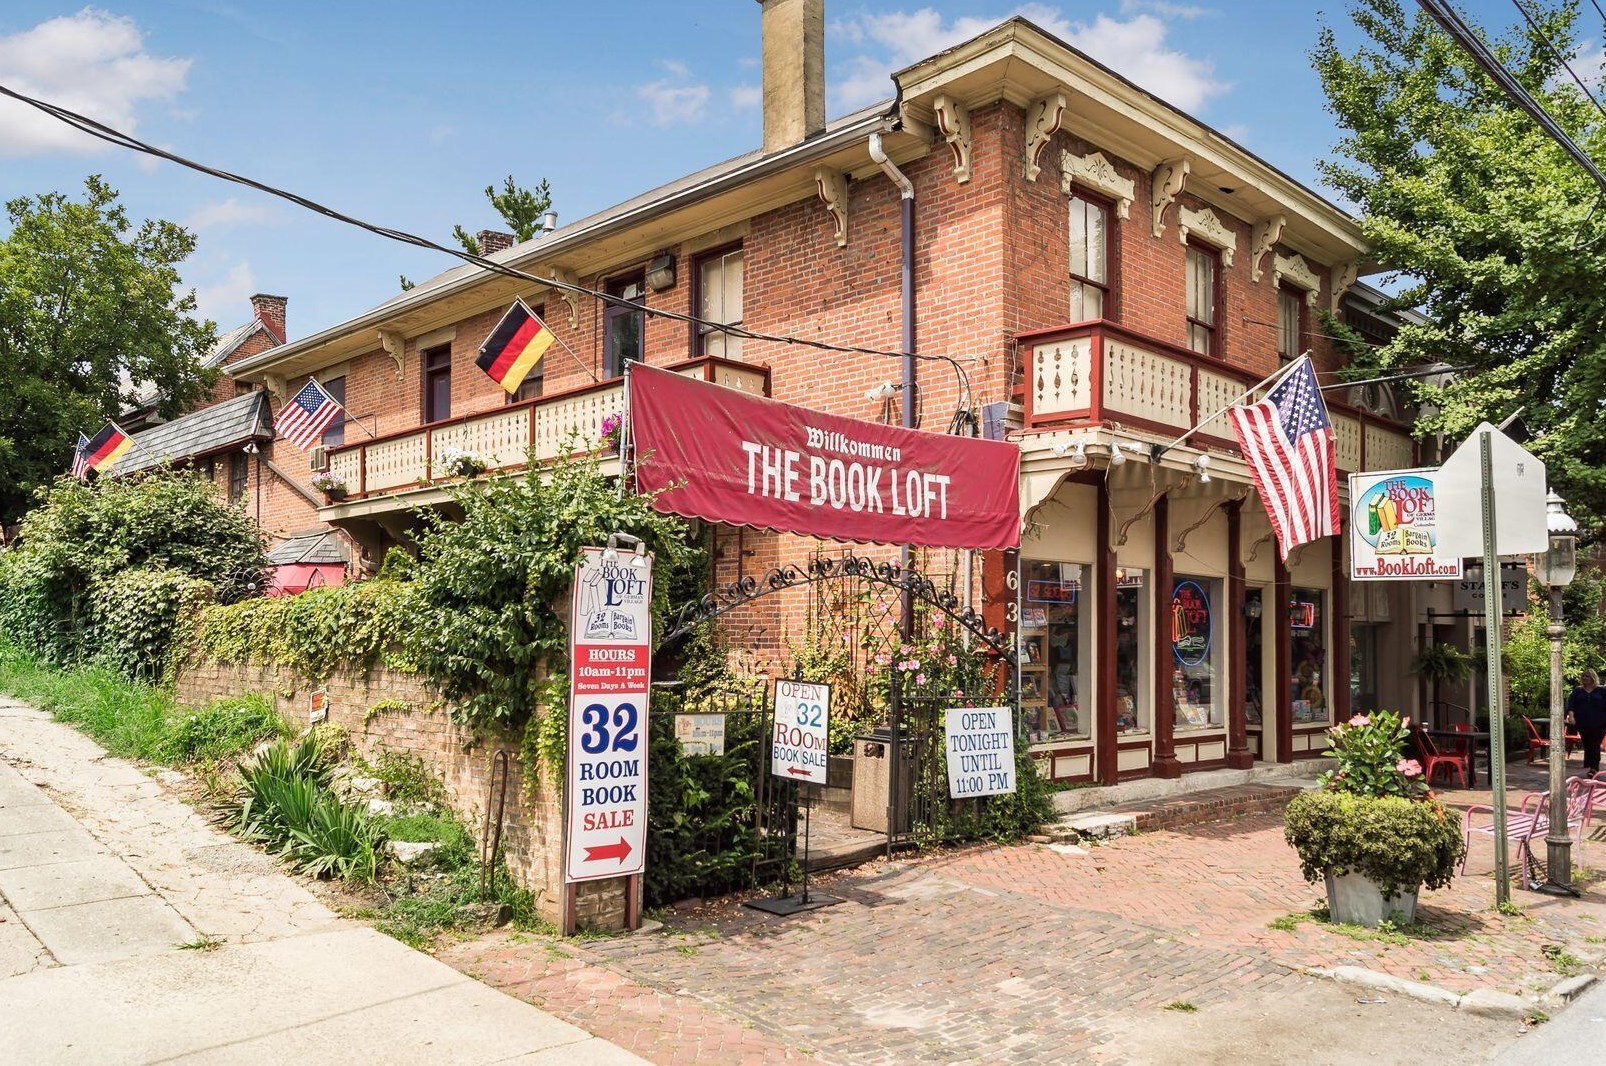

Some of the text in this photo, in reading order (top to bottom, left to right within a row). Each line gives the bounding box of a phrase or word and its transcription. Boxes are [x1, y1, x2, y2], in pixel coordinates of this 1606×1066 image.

[805, 425, 901, 461] Willkommen
[741, 440, 951, 520] THE BOOK LOFT
[1383, 480, 1406, 490] THE
[1389, 486, 1431, 502] BOOK
[1381, 539, 1401, 548] Rooms
[1405, 530, 1428, 541] Bargain
[1405, 538, 1427, 548] Books
[602, 566, 637, 580] BOOK
[1356, 556, 1457, 576] www.BookLoft.com
[604, 579, 646, 606] LOFT
[1460, 581, 1520, 590] STAF'S
[590, 622, 609, 631] Rooms
[594, 612, 606, 624] 32
[613, 612, 633, 625] Bargain
[613, 621, 633, 632] Books
[589, 649, 636, 661] HOURS
[579, 666, 645, 679] 10am-11pm
[578, 682, 599, 690] Seven
[601, 682, 618, 690] Days
[782, 681, 822, 700] OPEN
[797, 702, 822, 728] 32
[961, 712, 996, 731] OPEN
[581, 702, 638, 754] 32
[775, 722, 826, 751] ROOM
[951, 732, 1009, 753] TONIGHT
[773, 746, 826, 767] BOOK SALE
[961, 753, 1002, 773] UNTIL
[580, 759, 639, 781] ROOM
[956, 772, 1009, 794] 11:00 PM
[581, 784, 637, 806] BOOK
[583, 809, 634, 832] SALE
